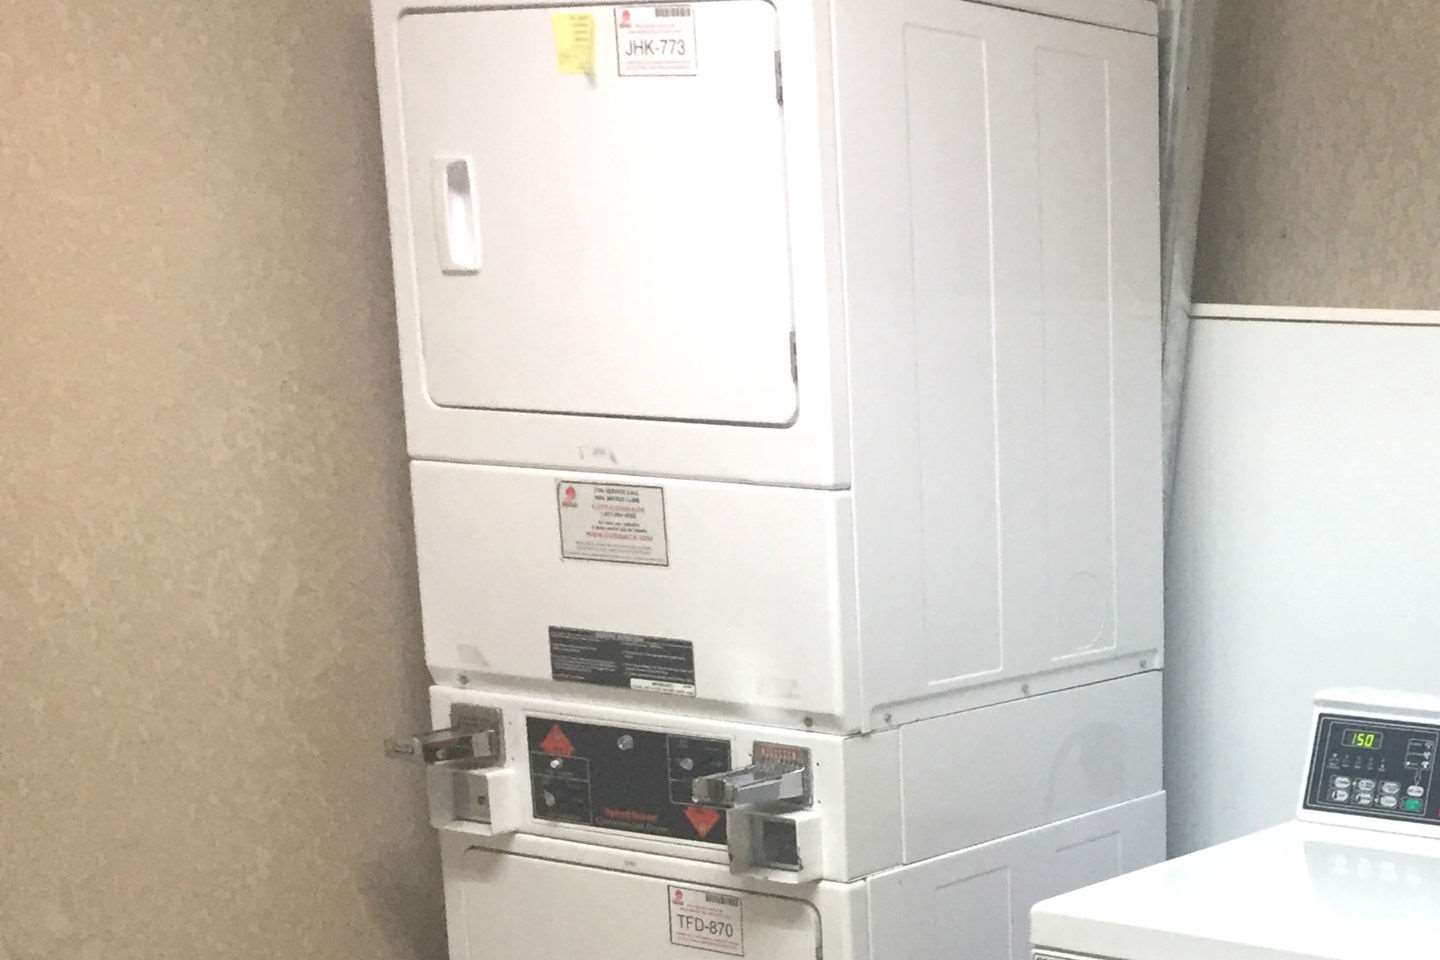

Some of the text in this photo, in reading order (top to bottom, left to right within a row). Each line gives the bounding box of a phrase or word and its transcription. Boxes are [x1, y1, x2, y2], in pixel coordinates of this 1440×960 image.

[625, 39, 686, 56] JHK-773
[1352, 732, 1375, 748] 150
[676, 913, 734, 938] TFD-870
